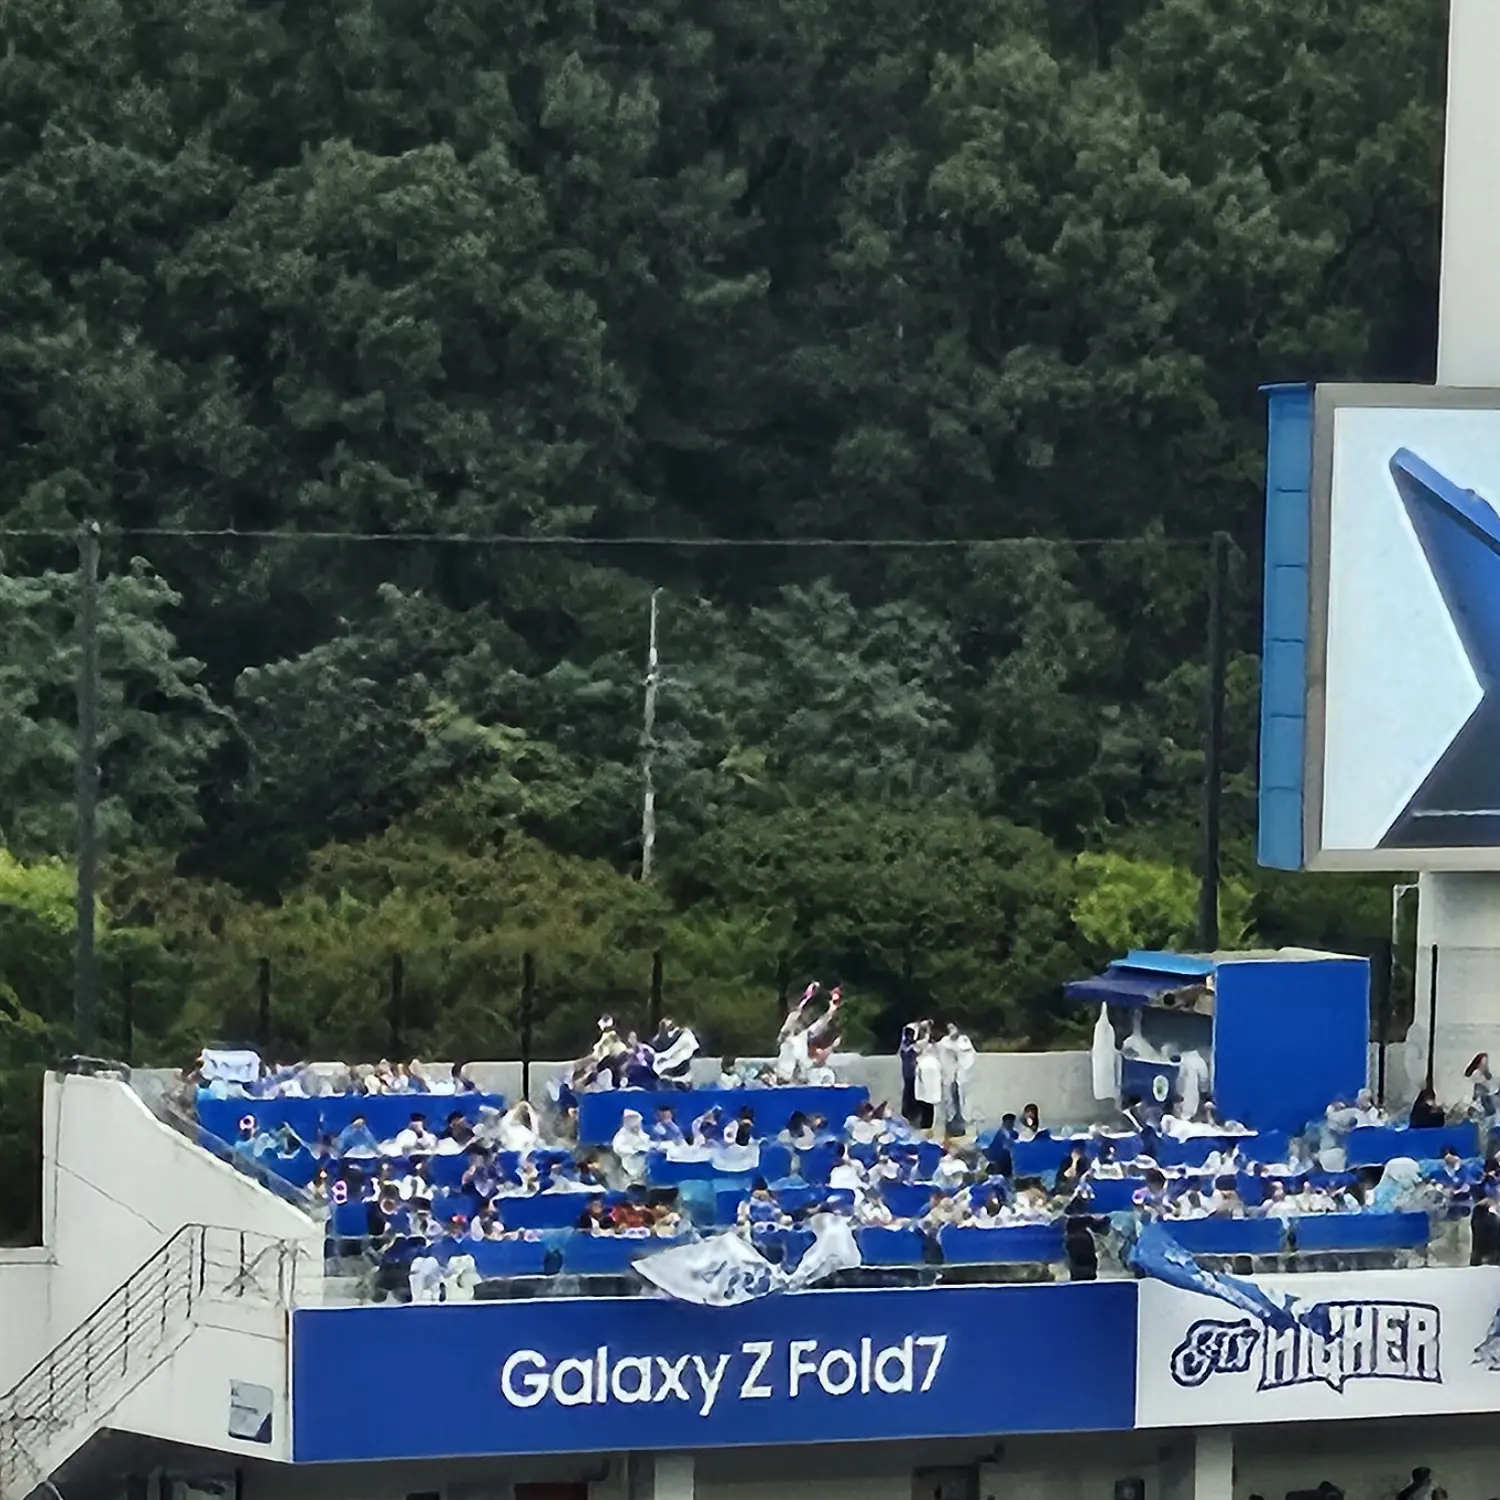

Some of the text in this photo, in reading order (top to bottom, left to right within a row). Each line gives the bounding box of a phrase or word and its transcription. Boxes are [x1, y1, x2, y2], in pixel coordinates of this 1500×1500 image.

[499, 1333, 949, 1417] Galaxy Z Fold7
